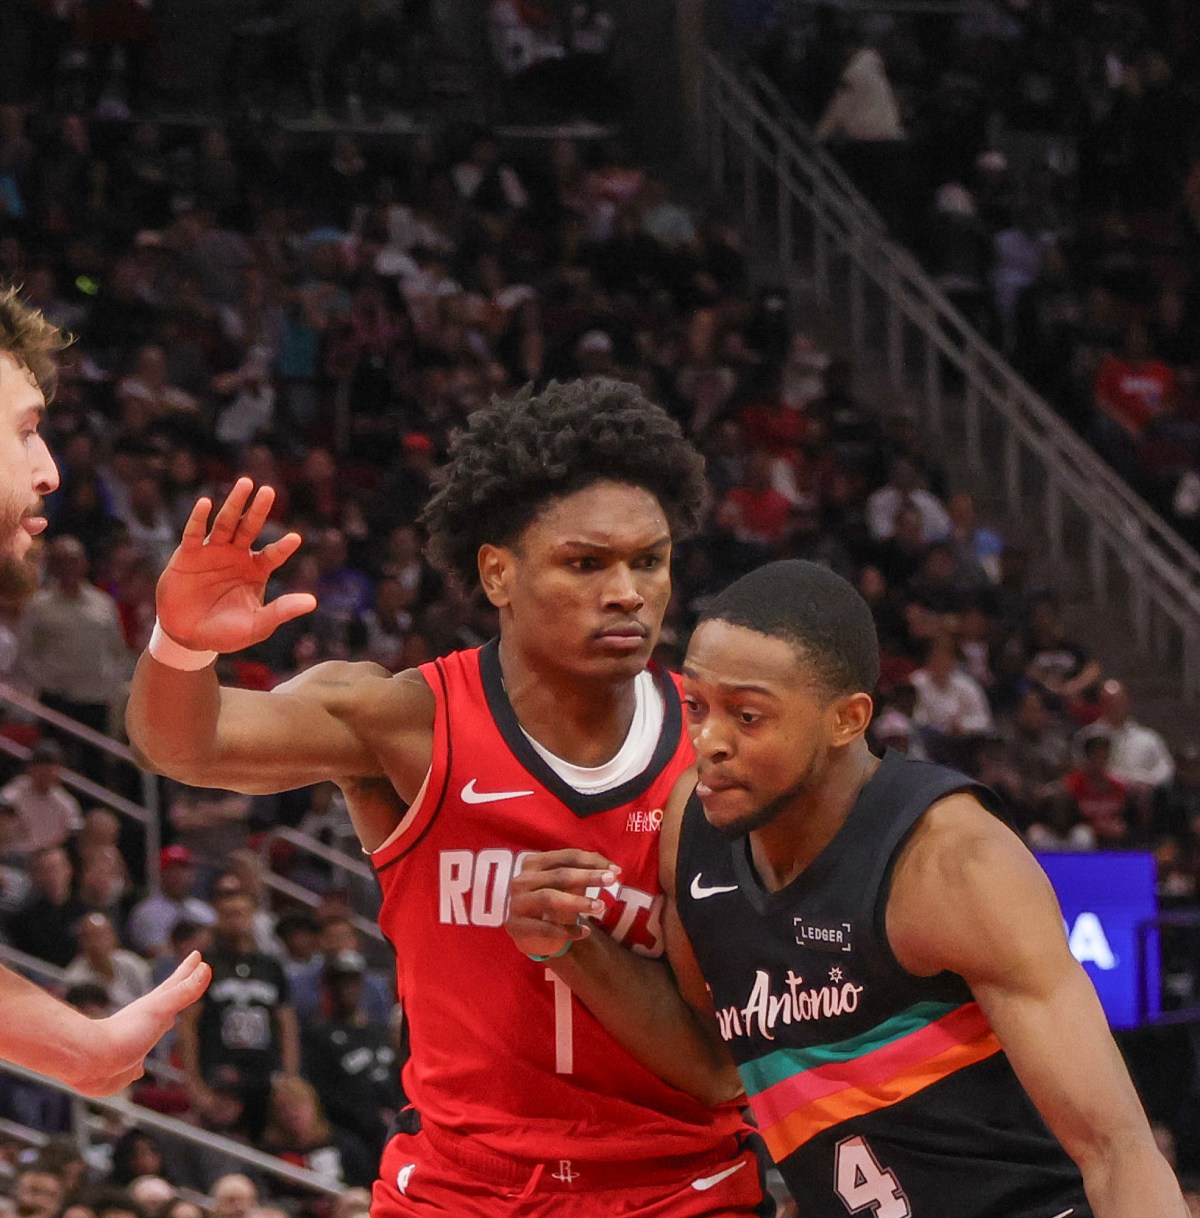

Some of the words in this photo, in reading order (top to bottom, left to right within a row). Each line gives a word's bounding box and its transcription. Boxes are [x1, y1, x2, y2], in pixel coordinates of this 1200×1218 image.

[439, 848, 667, 958] ROTS
[801, 926, 843, 943] LEDGER
[545, 967, 573, 1075] 1
[741, 967, 864, 1041] Antonio
